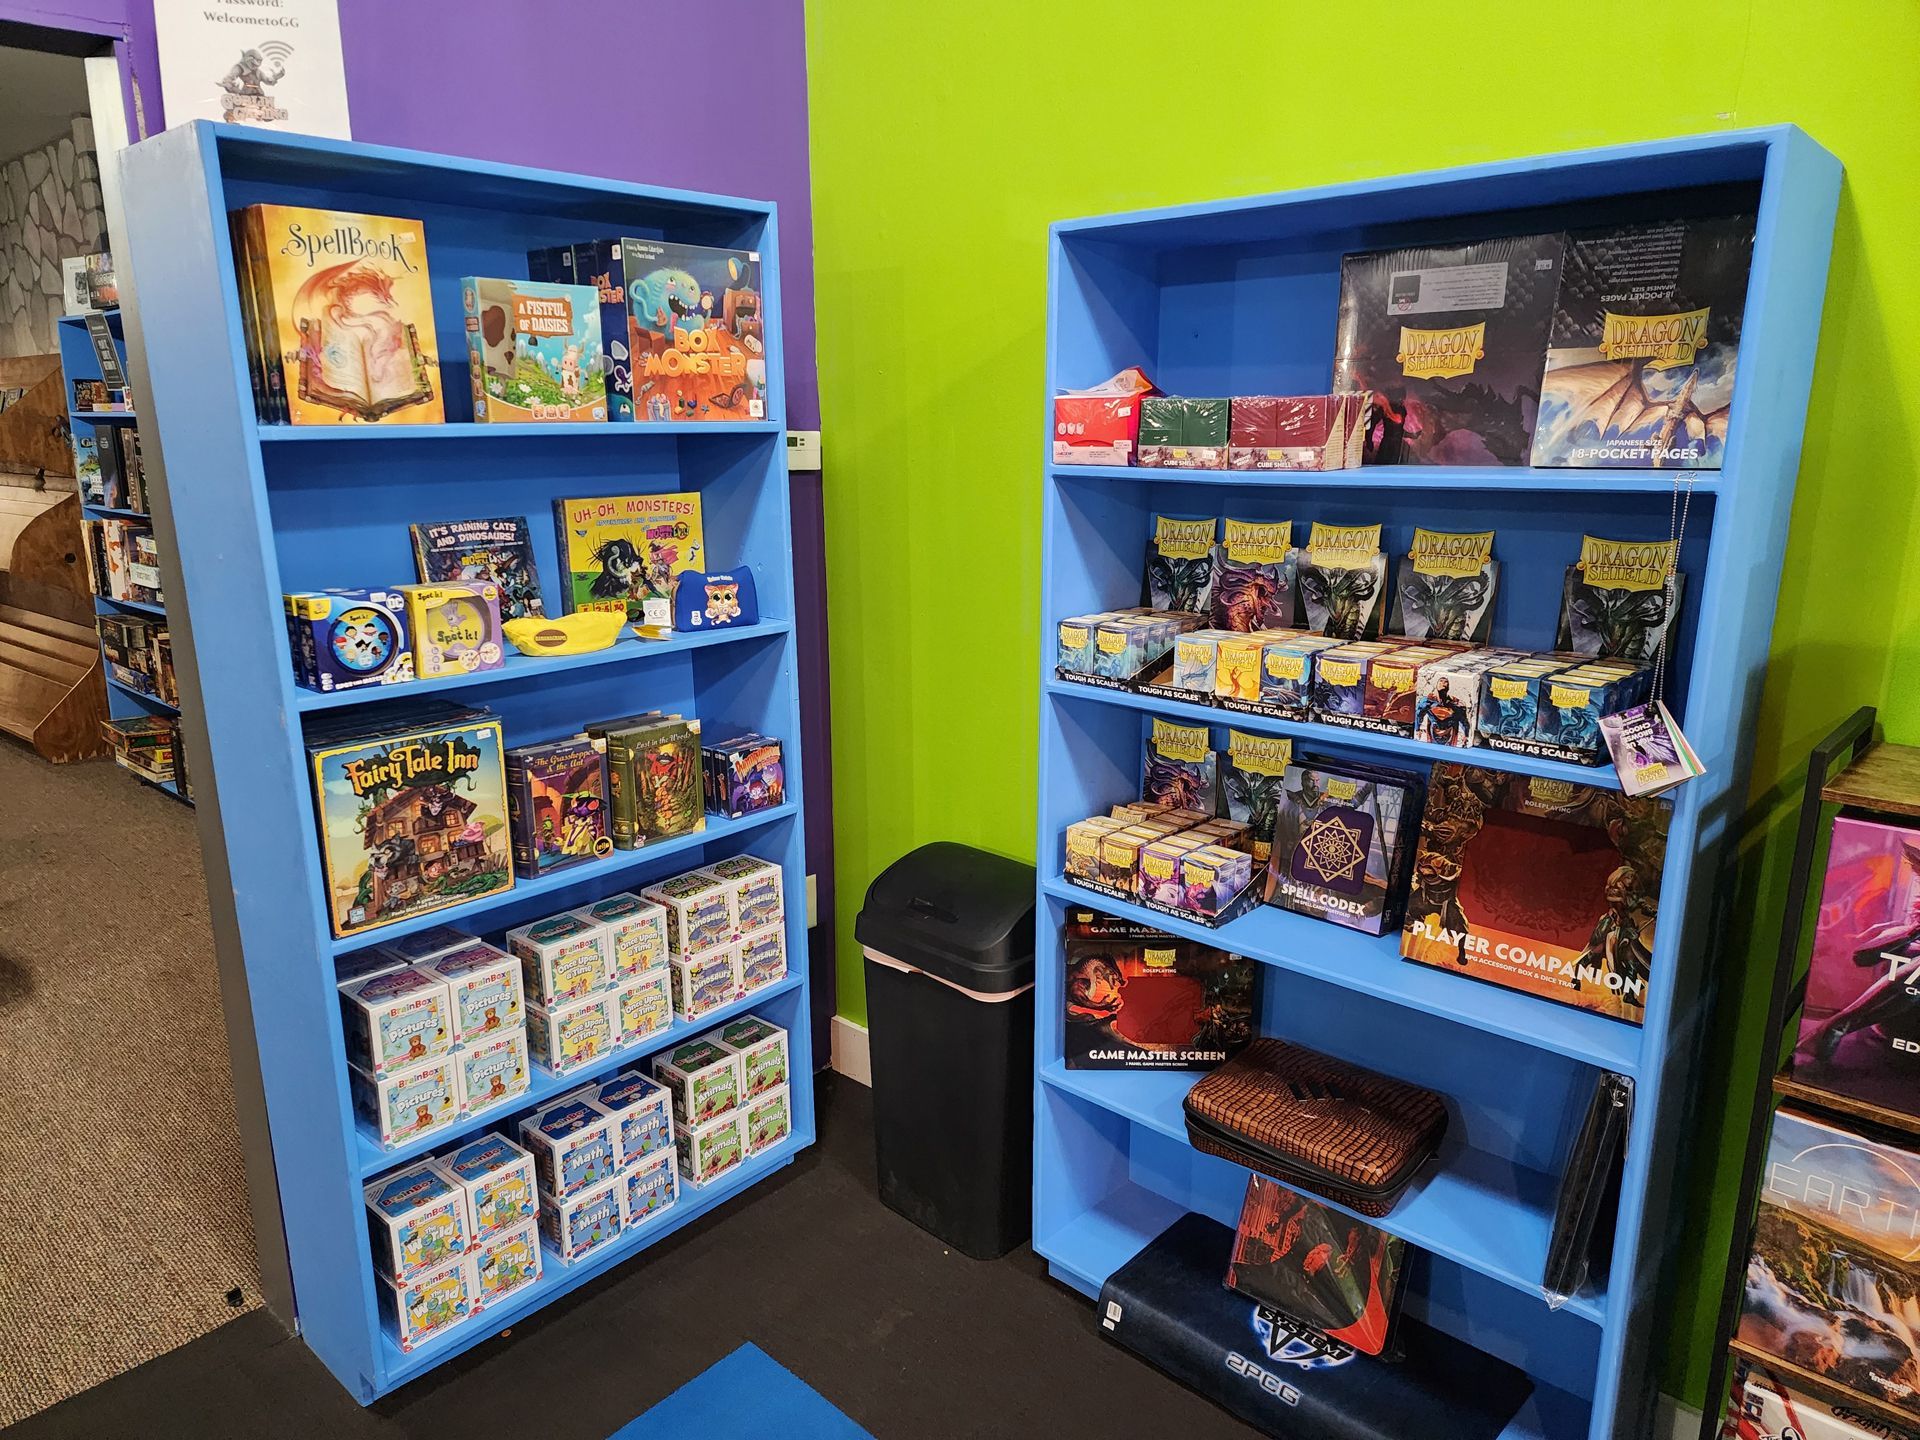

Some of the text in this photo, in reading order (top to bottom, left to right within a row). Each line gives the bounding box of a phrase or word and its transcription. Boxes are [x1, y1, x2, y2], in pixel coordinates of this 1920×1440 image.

[203, 11, 300, 28] WelcometoGG
[281, 223, 418, 273] SpellBook
[1600, 290, 1674, 302] 18-POCKET PAGES
[1646, 283, 1677, 292] JAPANESE
[518, 301, 567, 317] A FISTFUL
[520, 316, 568, 333] OF DAISIES
[1612, 316, 1702, 345] DRAGON
[674, 326, 721, 352] BOX
[1406, 330, 1479, 356] DRAGON
[1407, 354, 1473, 372] SHIELD
[1612, 342, 1692, 362] SHIELD
[643, 349, 747, 378] MONSTER
[1570, 448, 1699, 460] 18-POCKET PAGES
[1606, 439, 1662, 447] JAPANESE SIZE
[574, 500, 695, 523] UH-OH, MONSTERS!
[429, 522, 517, 538] IT'S RAINING CATS
[436, 535, 455, 548] AND
[458, 532, 514, 542] DINOSAURS!
[1160, 520, 1212, 542] DRAGON
[1230, 523, 1287, 546] DRAGON
[1315, 526, 1376, 550] DRAGON
[1161, 538, 1207, 555] SHIELD
[1231, 543, 1282, 559] SHIELD
[1418, 533, 1489, 557] DRAGON
[1588, 542, 1670, 569] DRAGON
[1416, 553, 1480, 572] SHIELD
[1588, 565, 1661, 585] SHIELD
[437, 630, 478, 644] Spot it!
[1065, 673, 1119, 688] TOUGH AS SCALES
[1138, 685, 1199, 701] TOUGH AS SCALES
[1224, 701, 1251, 711] TOUGH
[1263, 707, 1292, 718] SCALES
[1321, 713, 1399, 734] TOUGH AS SCALES
[636, 741, 650, 749] Lost
[670, 732, 691, 741] Woods
[1490, 738, 1579, 761] TOUGH AS SCALES
[344, 741, 479, 796] Fairy Tale Inn
[535, 757, 549, 766] The
[550, 750, 594, 765] Grasshopper
[556, 763, 567, 771] the
[570, 760, 584, 768] Ant
[1524, 800, 1572, 814] ROLEPLAYING
[1073, 877, 1126, 899] TOUGH AS SCALES
[740, 892, 778, 911] Dinosaurs
[1281, 883, 1366, 916] SPELL CODEX
[689, 911, 727, 931] Dinosaurs
[1090, 926, 1127, 934] GAME
[620, 932, 658, 951] Once Upon
[635, 942, 653, 954] Time
[557, 954, 599, 974] Once Upon
[744, 949, 779, 968] Dinosaurs
[1412, 920, 1642, 996] PLAYER COMPANION
[468, 971, 506, 991] BrainBox
[573, 966, 592, 977] Time
[693, 970, 731, 992] Dinosaurs
[1464, 953, 1577, 990] RPG ACCESSORY BOX & DICE TRAY
[390, 997, 432, 1017] BrainBox
[466, 990, 512, 1015] Pictures
[389, 1016, 439, 1043] Pictures
[1089, 1050, 1226, 1061] GAME MASTER SCREEN
[472, 1057, 517, 1083] Pictures
[750, 1057, 781, 1079] Animals
[396, 1086, 445, 1113] Pictures
[698, 1081, 734, 1105] Animals
[630, 1116, 660, 1141] Math
[751, 1110, 785, 1134] Animals
[571, 1145, 604, 1170] Math
[703, 1136, 739, 1160] Animals
[637, 1174, 665, 1197] Math
[481, 1186, 526, 1217] World
[579, 1205, 610, 1231] Math
[407, 1222, 455, 1255] World
[484, 1249, 529, 1281] World
[410, 1283, 460, 1319] World
[1264, 1309, 1341, 1358] SYSTEM
[1227, 1351, 1301, 1406] 2PCG
